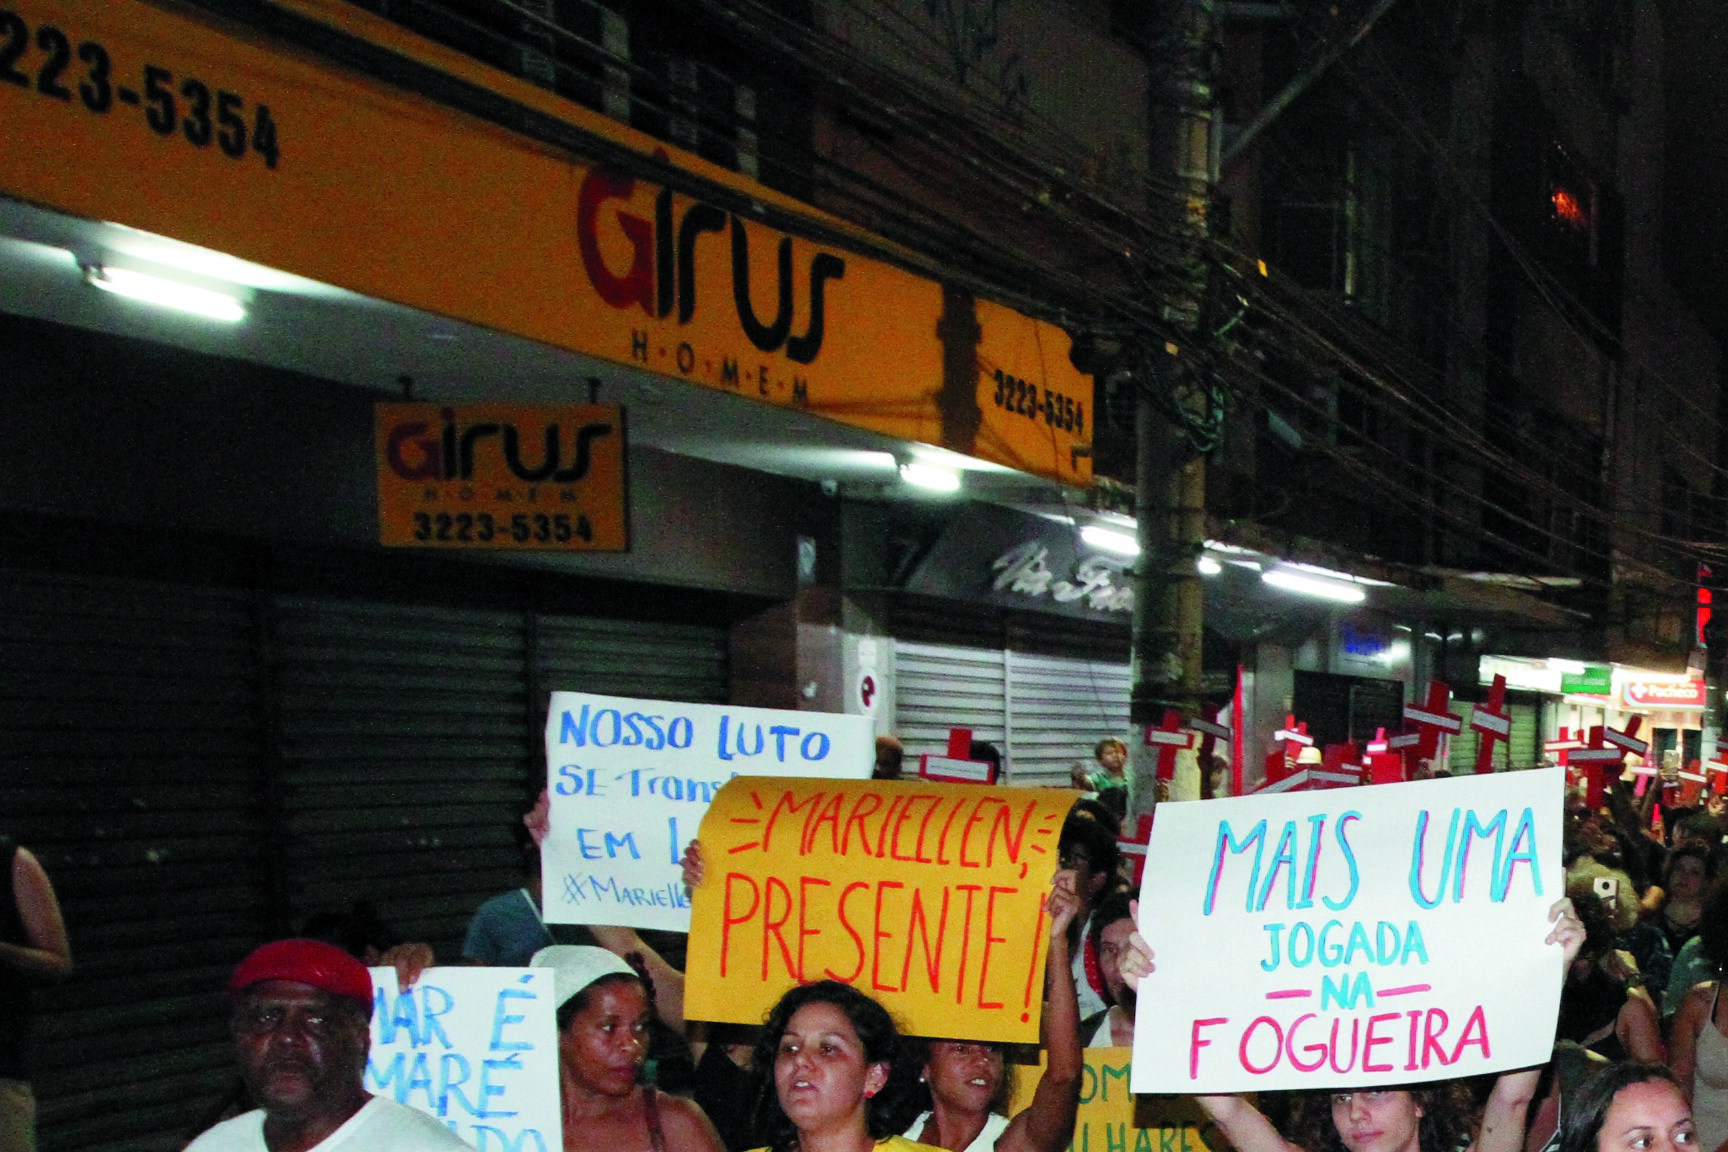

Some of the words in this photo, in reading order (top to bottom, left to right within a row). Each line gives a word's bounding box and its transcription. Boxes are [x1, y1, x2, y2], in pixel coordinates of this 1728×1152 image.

[994, 368, 1084, 436] 3223-5354
[413, 511, 593, 543] 3223-5354
[559, 704, 694, 751] NOSSO
[717, 715, 831, 762] LUTO
[555, 764, 609, 797] SE
[576, 827, 642, 861] EM
[1203, 809, 1361, 915] MAIS
[1408, 807, 1544, 909] UMA
[719, 872, 1046, 1023] PRESENTE!
[1261, 920, 1429, 972] JOGADA
[489, 975, 538, 1052] É
[1320, 971, 1375, 1011] NA
[1188, 1004, 1492, 1080] FOGUEIRA
